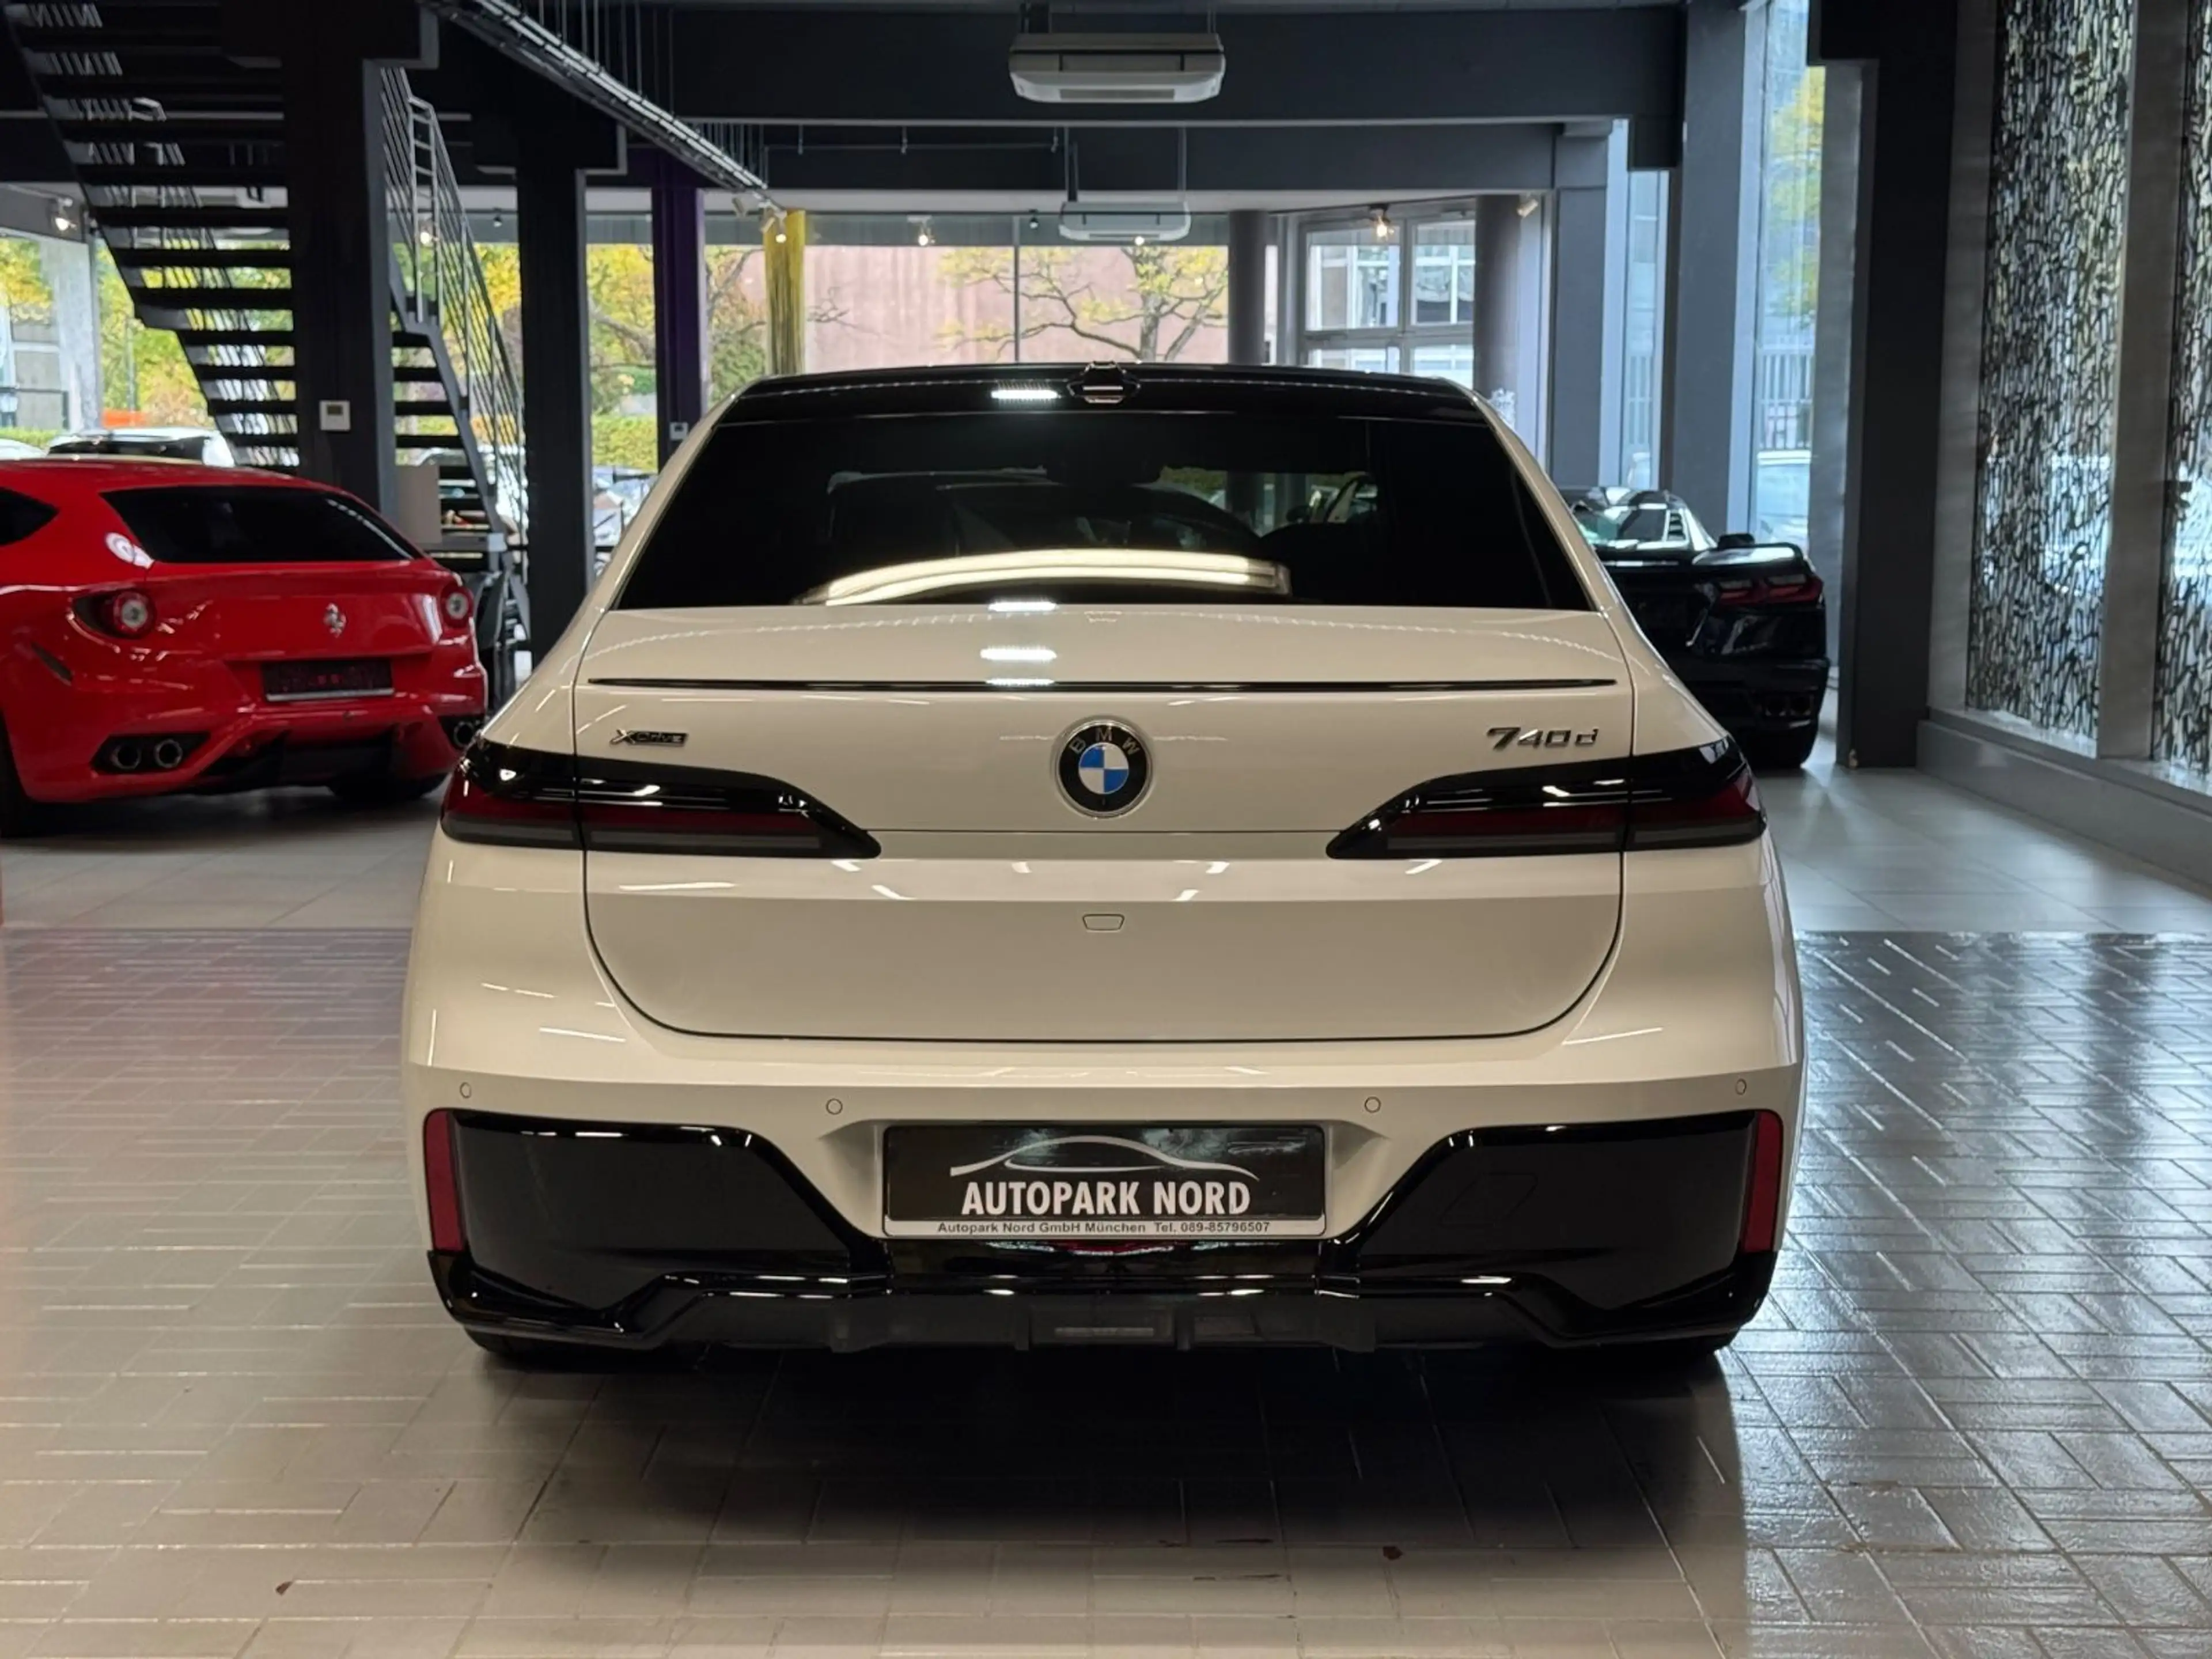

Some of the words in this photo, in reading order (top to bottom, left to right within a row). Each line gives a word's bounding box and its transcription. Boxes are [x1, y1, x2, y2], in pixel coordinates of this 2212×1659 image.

[1069, 727, 1140, 755] BMW
[1486, 726, 1599, 751] 740d
[961, 1181, 1140, 1215] AUTOPARK
[1154, 1181, 1251, 1215] NORD
[937, 1222, 998, 1235] Autopark
[1002, 1222, 1035, 1233] Nord
[1040, 1222, 1081, 1233] GmbH
[1085, 1222, 1146, 1233] München
[1155, 1222, 1176, 1233] Tel.
[1180, 1221, 1270, 1233] 089-85796507
